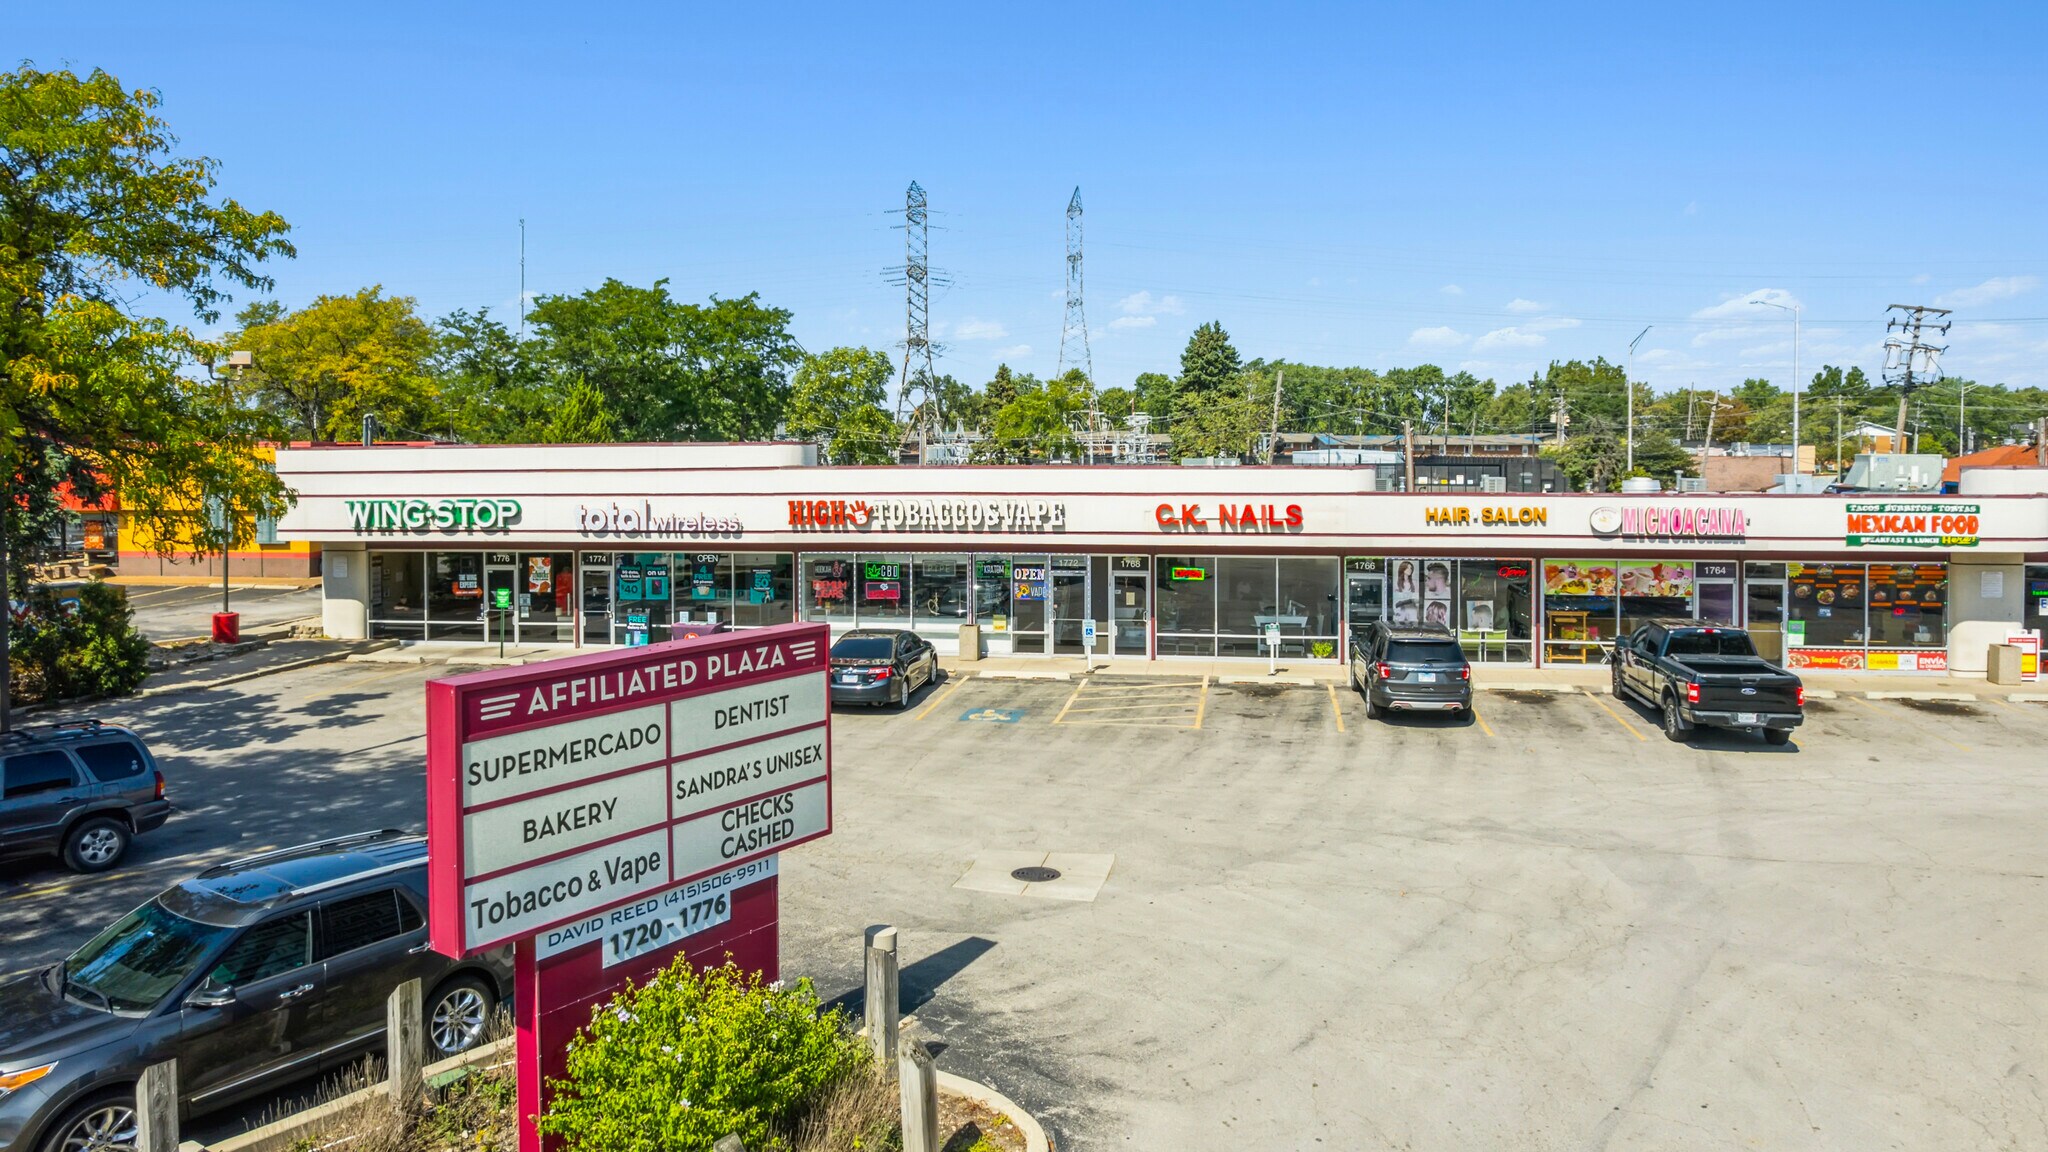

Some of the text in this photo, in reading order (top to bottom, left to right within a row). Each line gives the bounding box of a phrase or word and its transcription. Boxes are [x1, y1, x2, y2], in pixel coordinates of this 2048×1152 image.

[574, 499, 742, 532] total wireless
[788, 500, 846, 525] HIGH
[1218, 504, 1303, 527] NAILS
[1425, 507, 1547, 523] HAIR SALON
[1849, 503, 1977, 512] TACOS BURRITOS TORTAS
[1622, 506, 1746, 535] MICHOACANA
[1847, 513, 1979, 535] MEXICAN FOOD
[1860, 536, 1905, 544] BREAKFAST
[697, 554, 719, 562] OPEN
[880, 564, 898, 577] CBD
[1058, 559, 1079, 567] 1772
[1120, 560, 1141, 568] 1768
[1354, 561, 1376, 570] 1766
[1704, 566, 1726, 575] 1764
[1014, 568, 1046, 580] OPEN
[527, 644, 786, 715] AFFILIATED PLAZA
[714, 694, 790, 730] DENTIST
[467, 723, 662, 787] SUPERMERCADO
[676, 743, 823, 800] SANDRA'S UNISEX
[523, 797, 618, 843] BAKERY
[721, 793, 794, 832] CHECKS
[720, 818, 795, 859] CASHED
[471, 850, 661, 929] Tobacco & Vape
[548, 917, 604, 948] DAVID
[610, 898, 659, 926] REED
[609, 918, 663, 955] 1720
[679, 892, 727, 928] 1776
